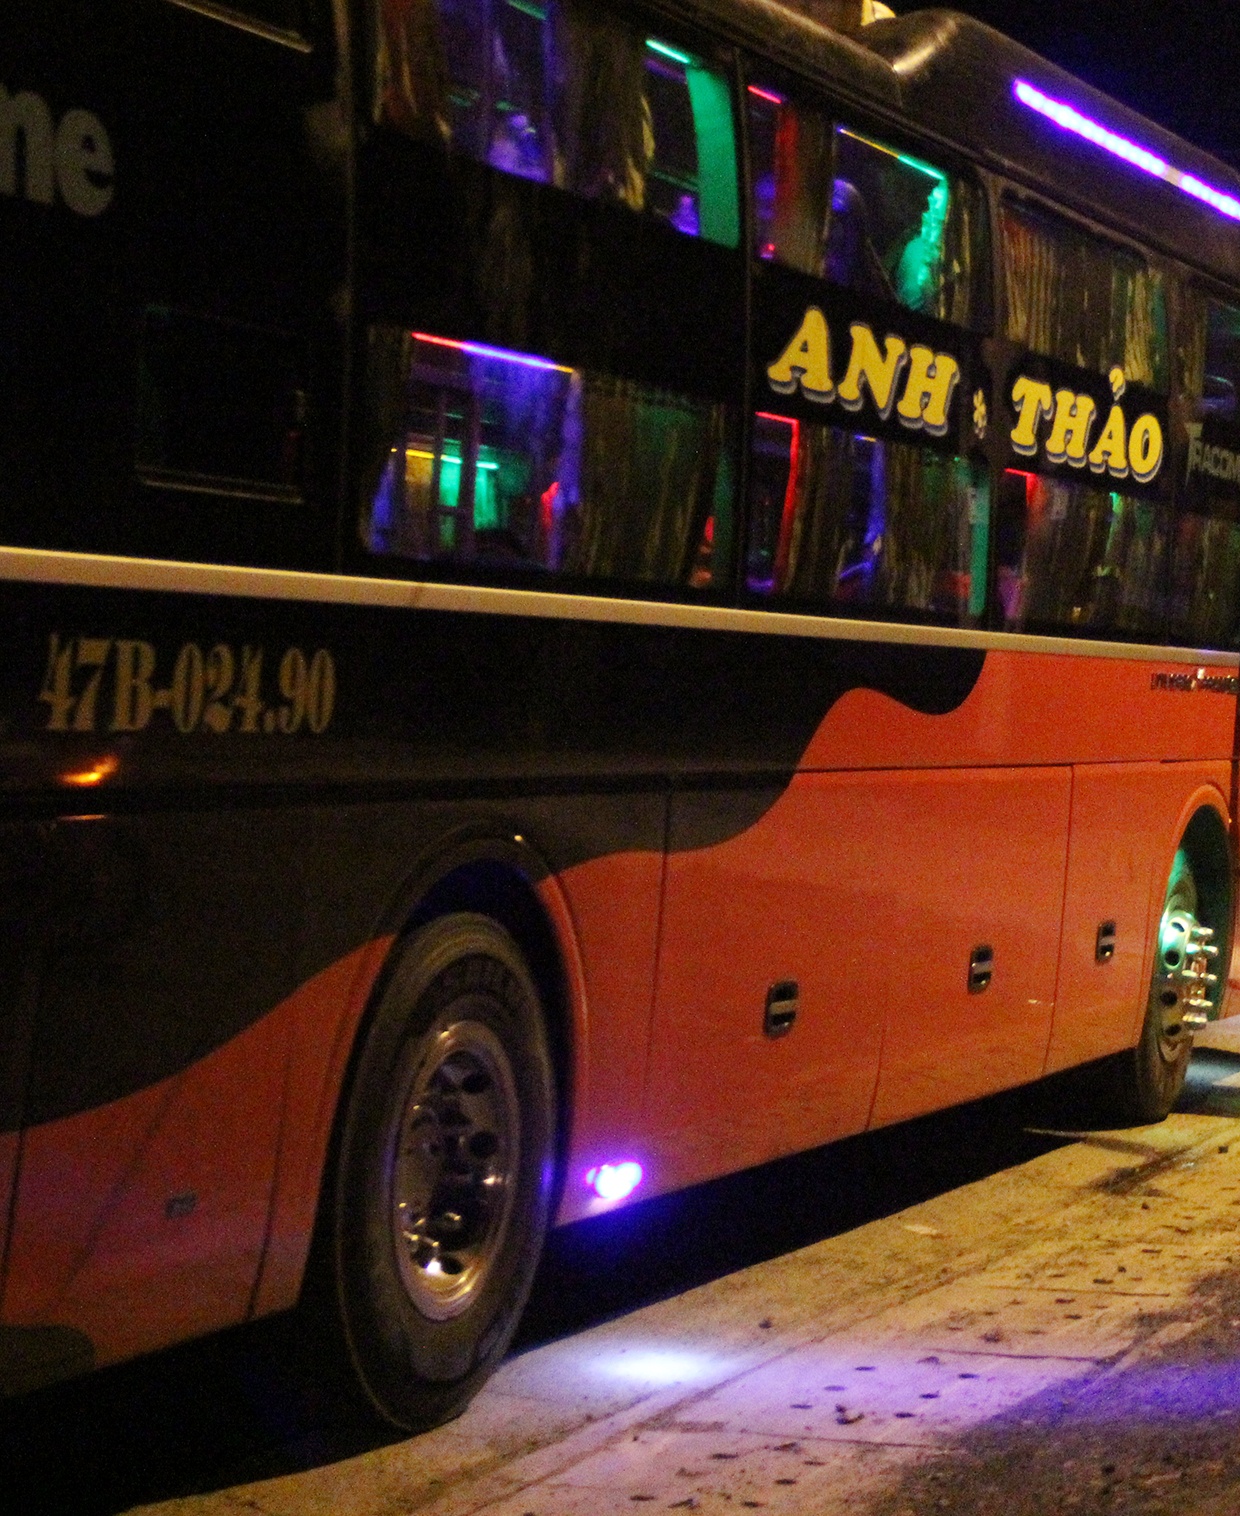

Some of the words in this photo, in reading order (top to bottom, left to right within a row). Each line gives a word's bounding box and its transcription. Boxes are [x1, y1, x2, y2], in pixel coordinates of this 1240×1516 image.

[767, 304, 961, 437] ANH
[1011, 365, 1163, 484] THẢO
[38, 632, 337, 735] 47B-024.90
